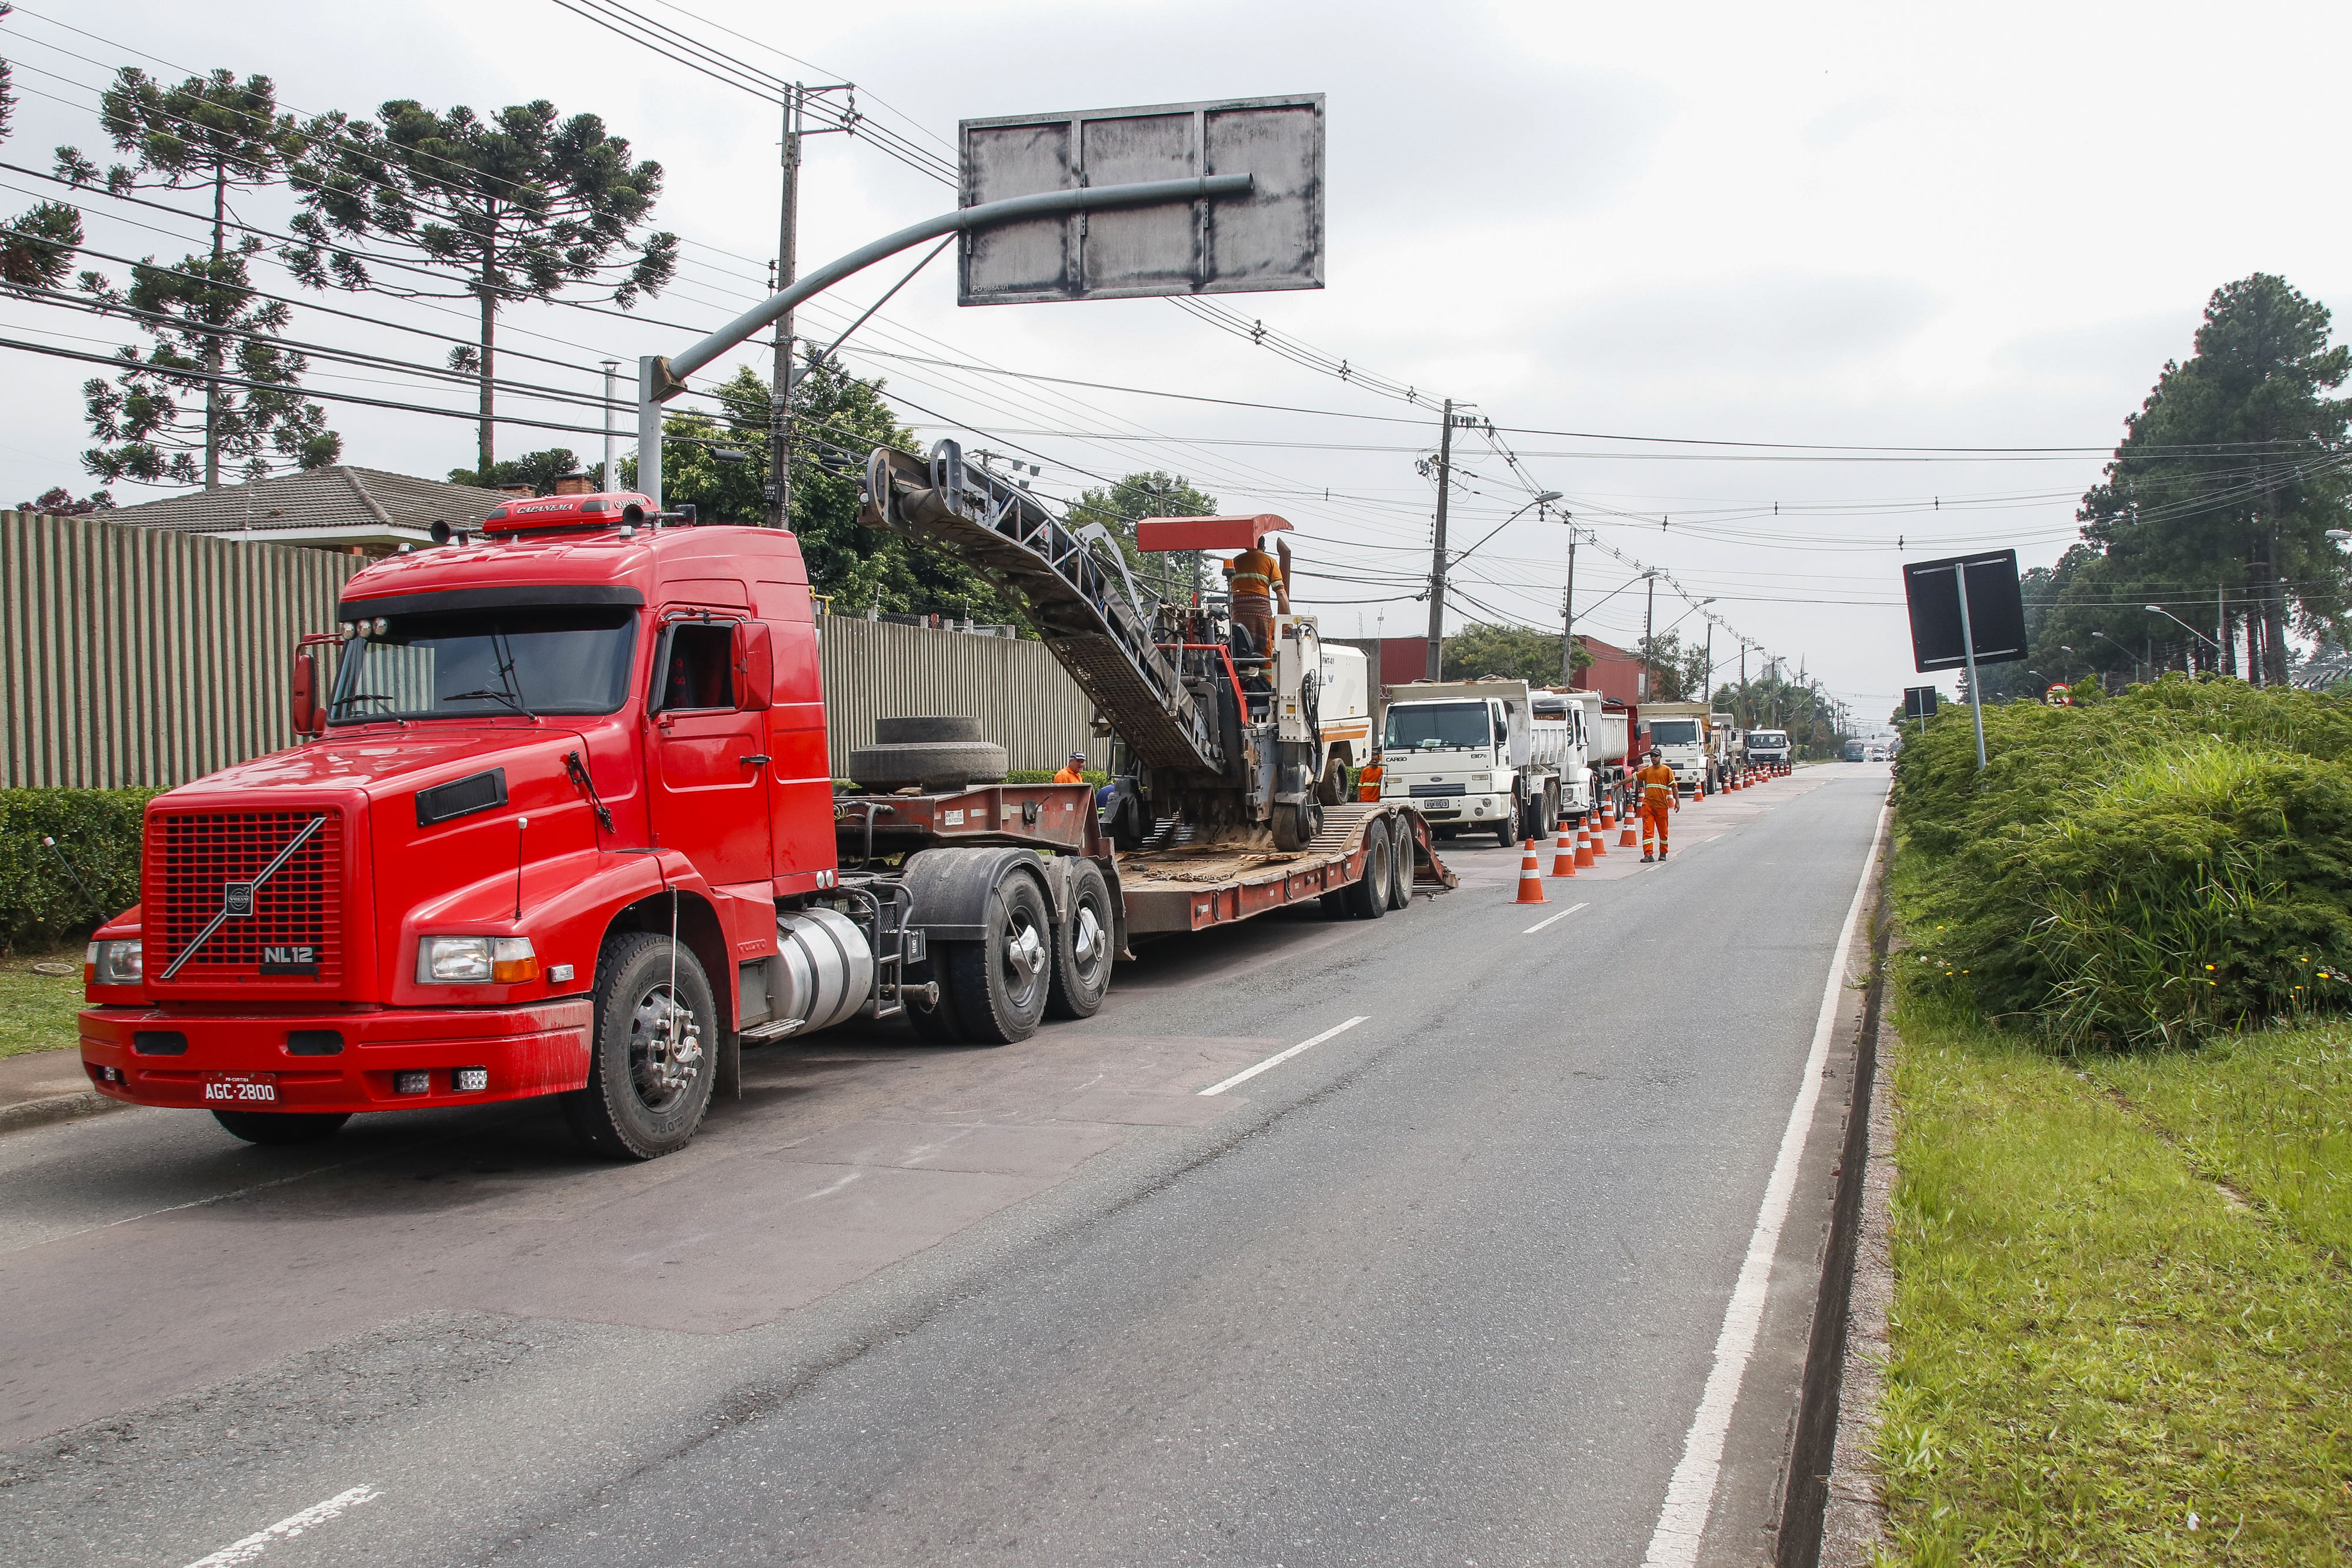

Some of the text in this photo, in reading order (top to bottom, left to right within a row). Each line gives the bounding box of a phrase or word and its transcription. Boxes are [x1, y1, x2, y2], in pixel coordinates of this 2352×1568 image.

[517, 504, 574, 514] CAPANEMA
[614, 497, 647, 509] CAPANEMA
[265, 947, 313, 962] NL12
